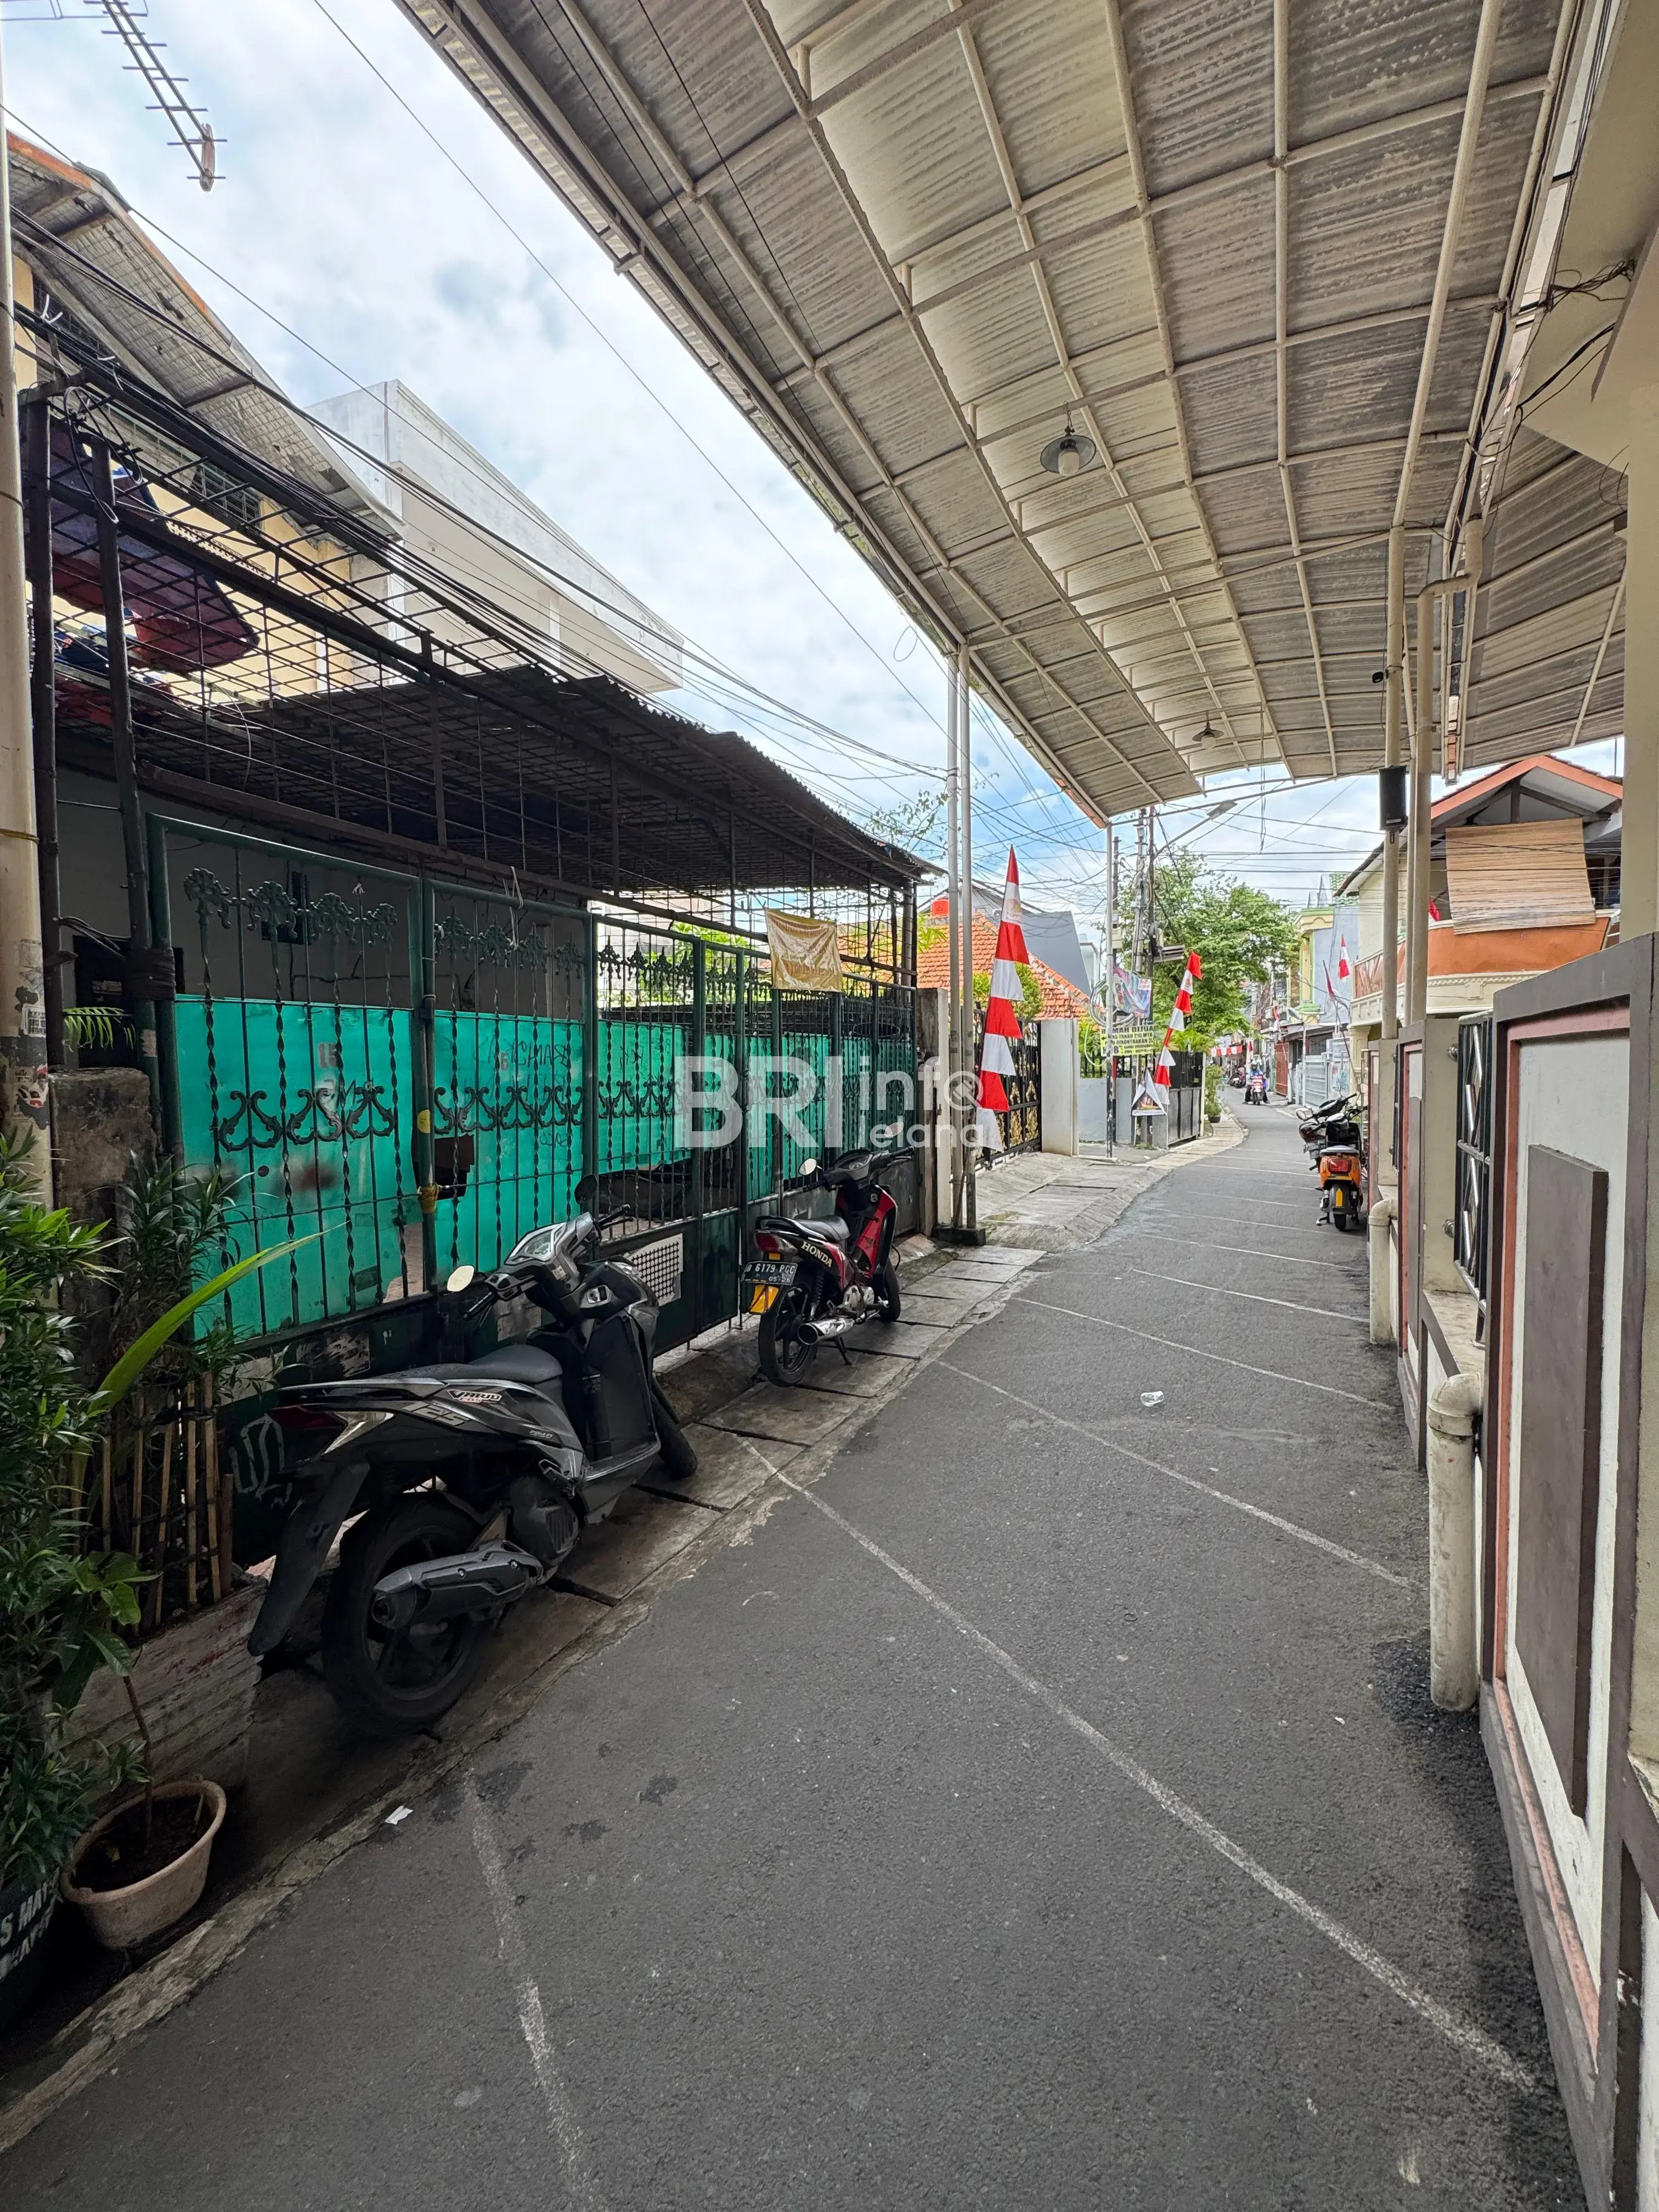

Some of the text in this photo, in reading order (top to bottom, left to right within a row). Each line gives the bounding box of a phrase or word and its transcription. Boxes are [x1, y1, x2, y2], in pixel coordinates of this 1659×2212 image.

[801, 1240, 833, 1268] HONDA
[755, 1263, 776, 1272] 6179
[448, 1390, 502, 1401] VARIO
[401, 1401, 472, 1426] 125
